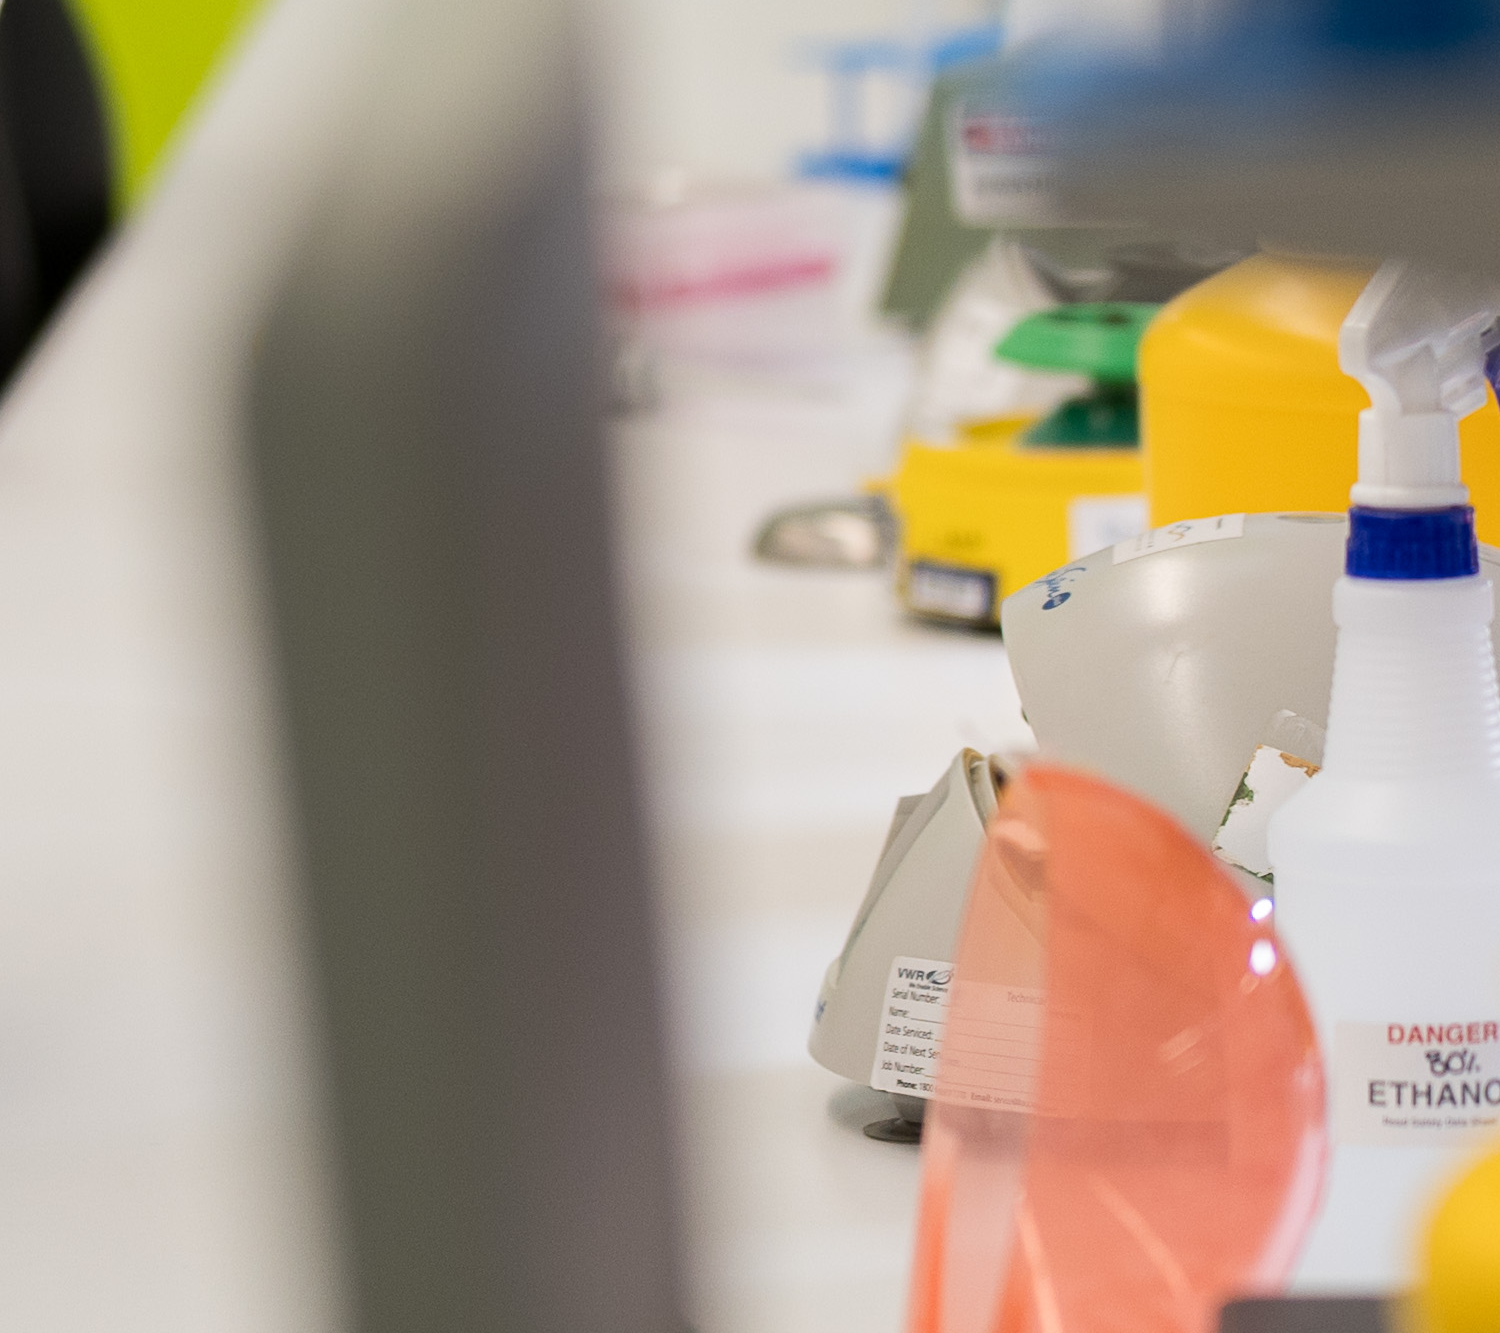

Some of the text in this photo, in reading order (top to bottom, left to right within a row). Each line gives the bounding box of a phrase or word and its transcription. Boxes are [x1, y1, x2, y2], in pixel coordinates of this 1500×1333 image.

[897, 967, 925, 981] VWR
[891, 988, 941, 1005] Serial Number:
[885, 1023, 934, 1040] Date Serviced:
[1388, 1021, 1498, 1044] DANGER
[883, 1041, 898, 1054] Date
[900, 1044, 909, 1055] of
[909, 1045, 926, 1058] Next
[881, 1059, 893, 1071] Job
[896, 1078, 918, 1091] Phone:
